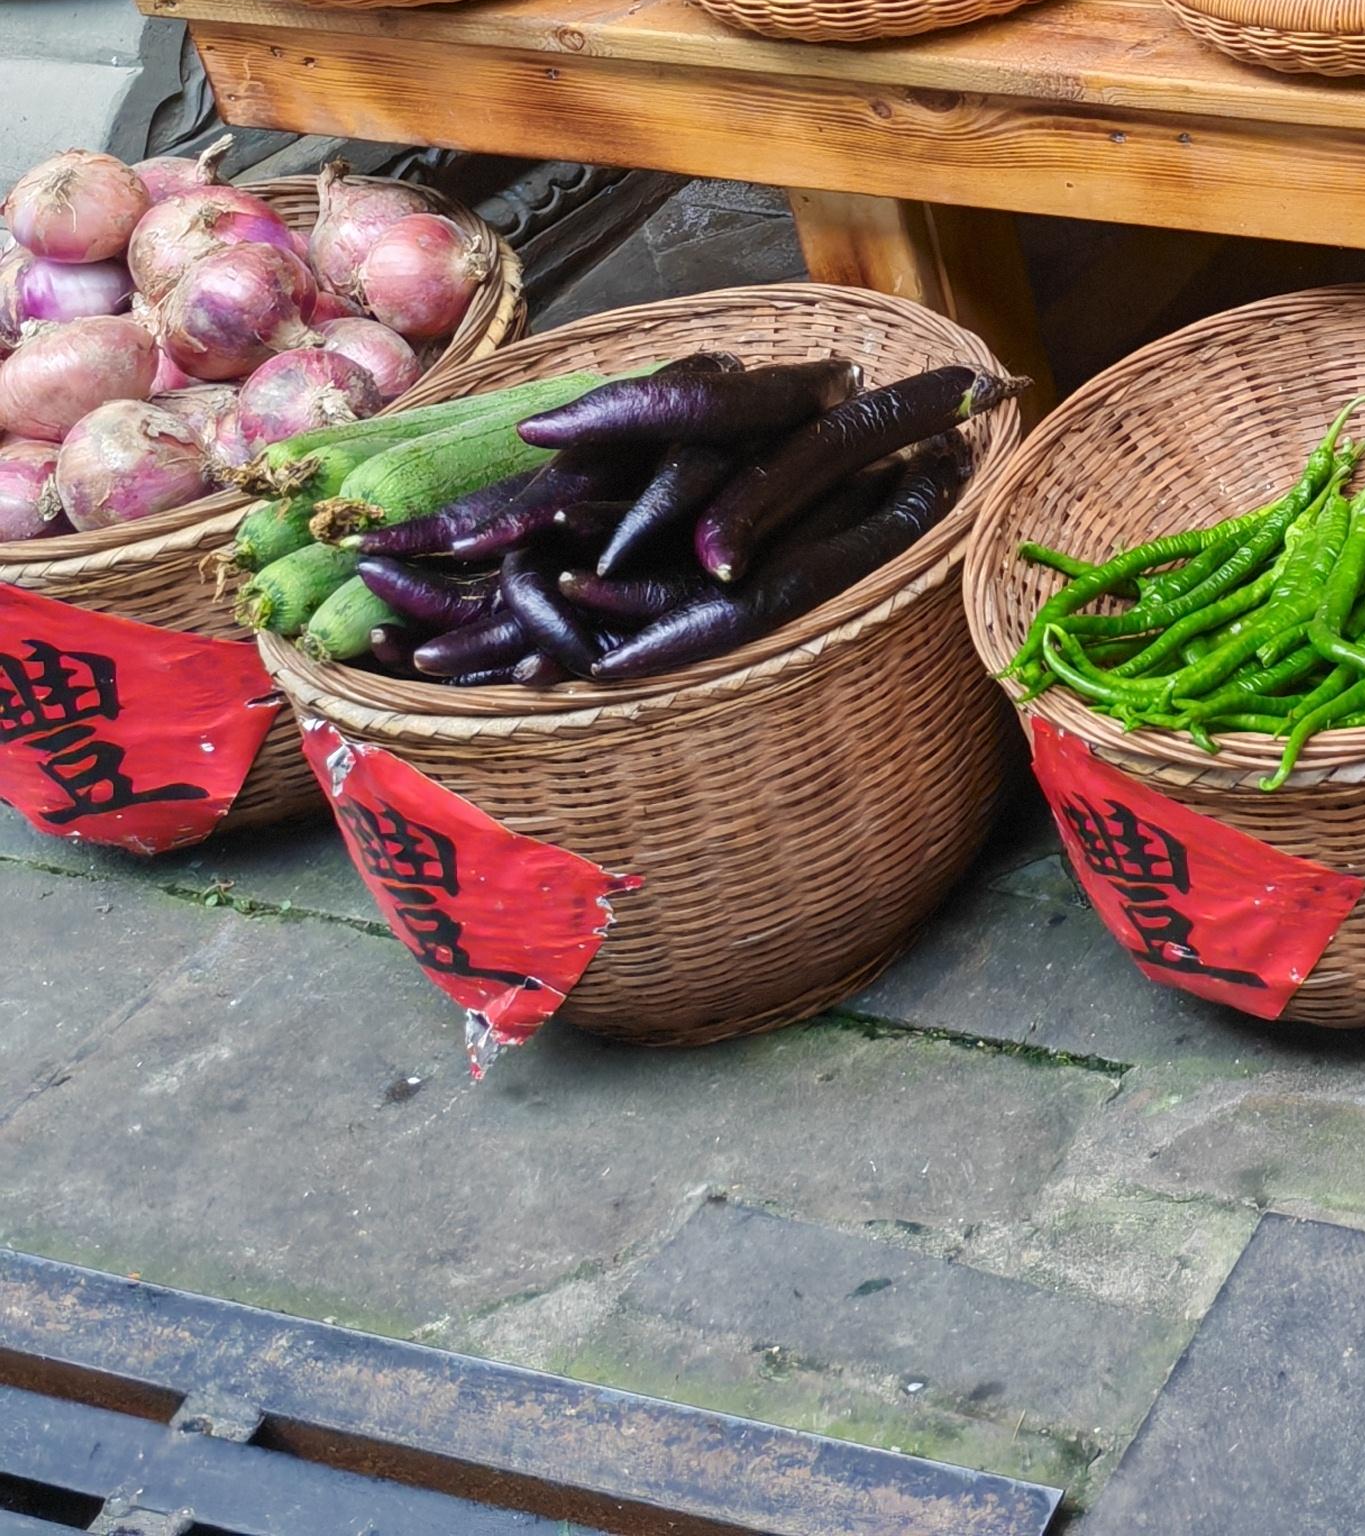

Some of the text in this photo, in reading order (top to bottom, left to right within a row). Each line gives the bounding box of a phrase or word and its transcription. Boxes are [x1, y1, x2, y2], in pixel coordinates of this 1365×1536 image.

[0, 639, 209, 825] 豐
[338, 797, 543, 991] 豐
[1057, 790, 1269, 990] 豐
